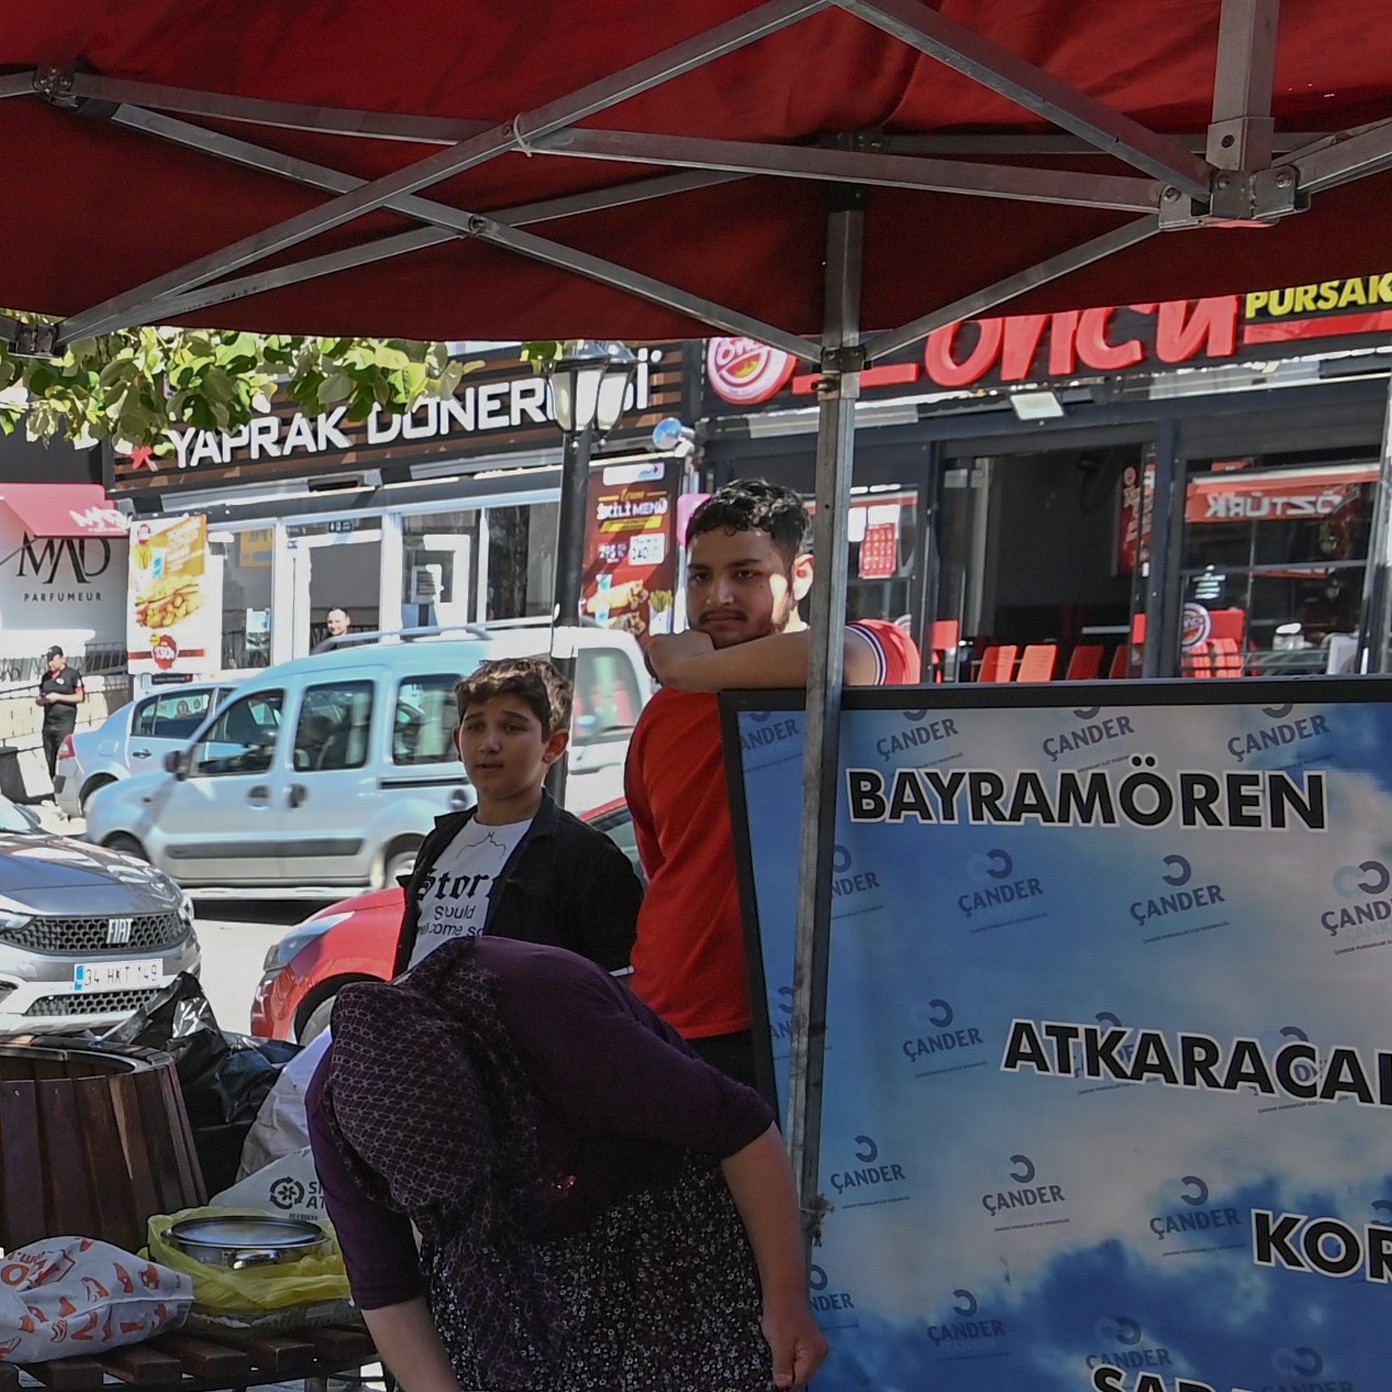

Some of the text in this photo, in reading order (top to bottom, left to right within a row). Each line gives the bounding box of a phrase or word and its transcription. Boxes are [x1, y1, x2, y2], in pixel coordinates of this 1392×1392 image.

[167, 404, 354, 469] YAPRAK
[16, 529, 111, 584] MAD
[24, 592, 102, 602] PARFUMEUR
[876, 717, 959, 763] ÇANDER
[1042, 715, 1135, 763] ÇANDER
[1227, 714, 1330, 763] ÇANDER
[847, 753, 1328, 832] BAYRAMÖREN
[832, 872, 880, 898] NDER
[958, 878, 1045, 918] ÇANDER
[1130, 884, 1226, 927] ÇANDER
[1321, 898, 1392, 937] ÇAND
[106, 918, 134, 944] FIAT
[84, 968, 100, 986] 34
[106, 966, 131, 984] HKT
[902, 1027, 984, 1063] ÇANDER
[830, 1163, 906, 1195] ÇANDER
[981, 1184, 1066, 1217] ÇANDER
[1149, 1207, 1242, 1241] ÇANDER
[810, 1292, 855, 1312] NDER
[927, 1319, 1006, 1347] ÇANDER
